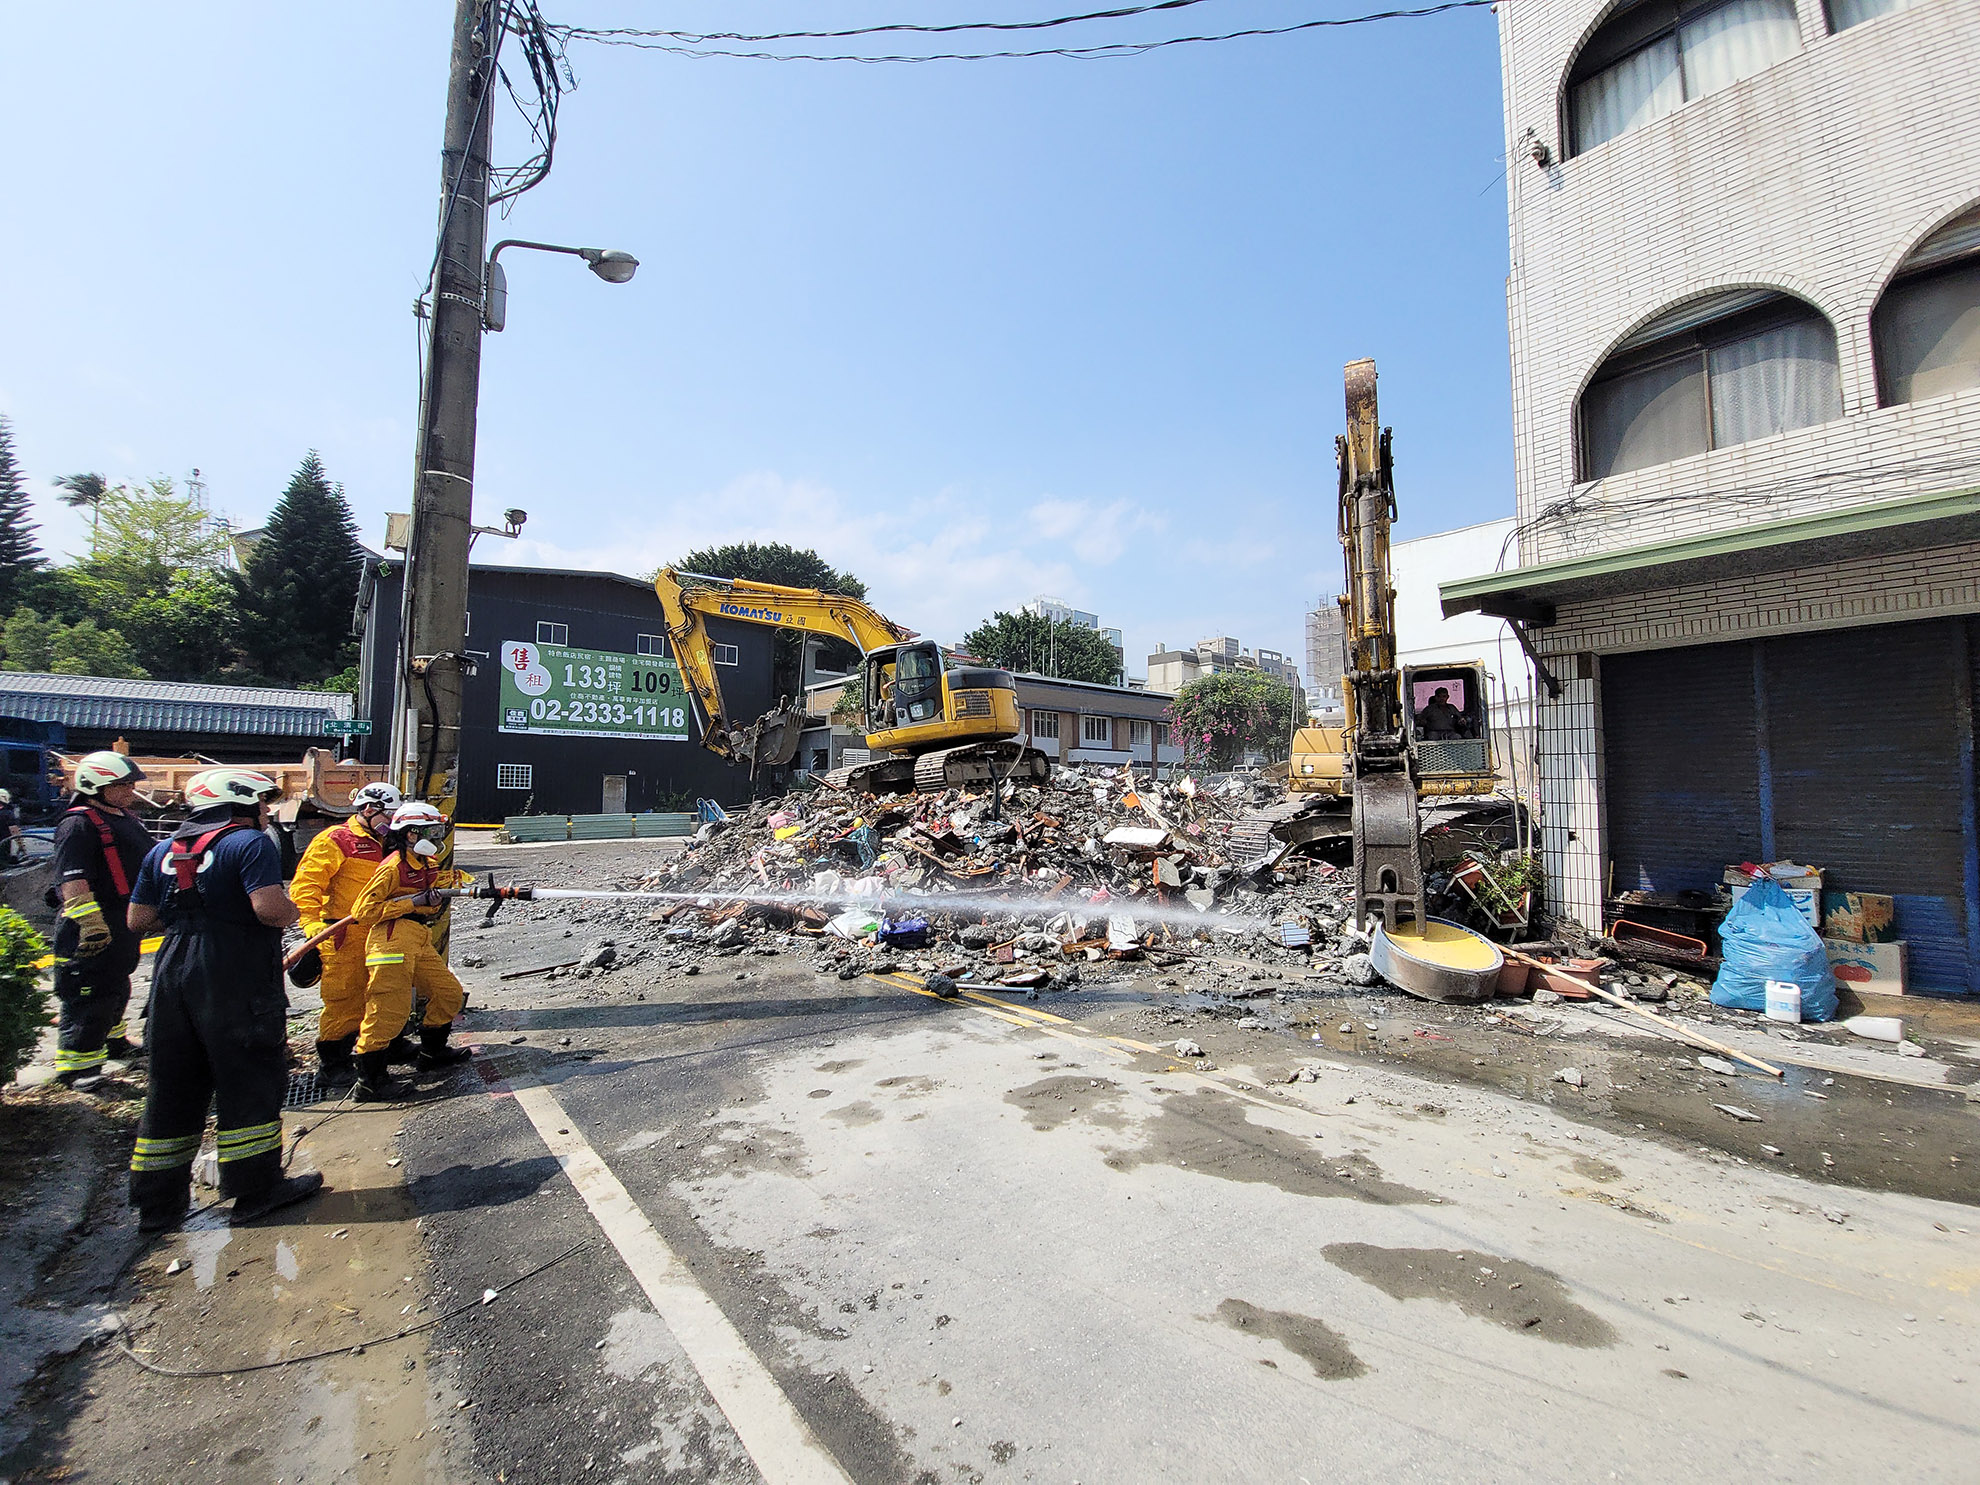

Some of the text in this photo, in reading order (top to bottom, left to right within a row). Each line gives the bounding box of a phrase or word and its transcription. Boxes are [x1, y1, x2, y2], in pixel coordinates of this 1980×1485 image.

[720, 603, 782, 622] KOMATSU
[511, 648, 531, 671] 售
[525, 673, 543, 688] 租
[563, 664, 607, 690] 133
[631, 670, 671, 694] 109
[608, 682, 621, 694] 坪
[671, 686, 684, 699] 坪
[531, 698, 684, 728] 02-2333-1118
